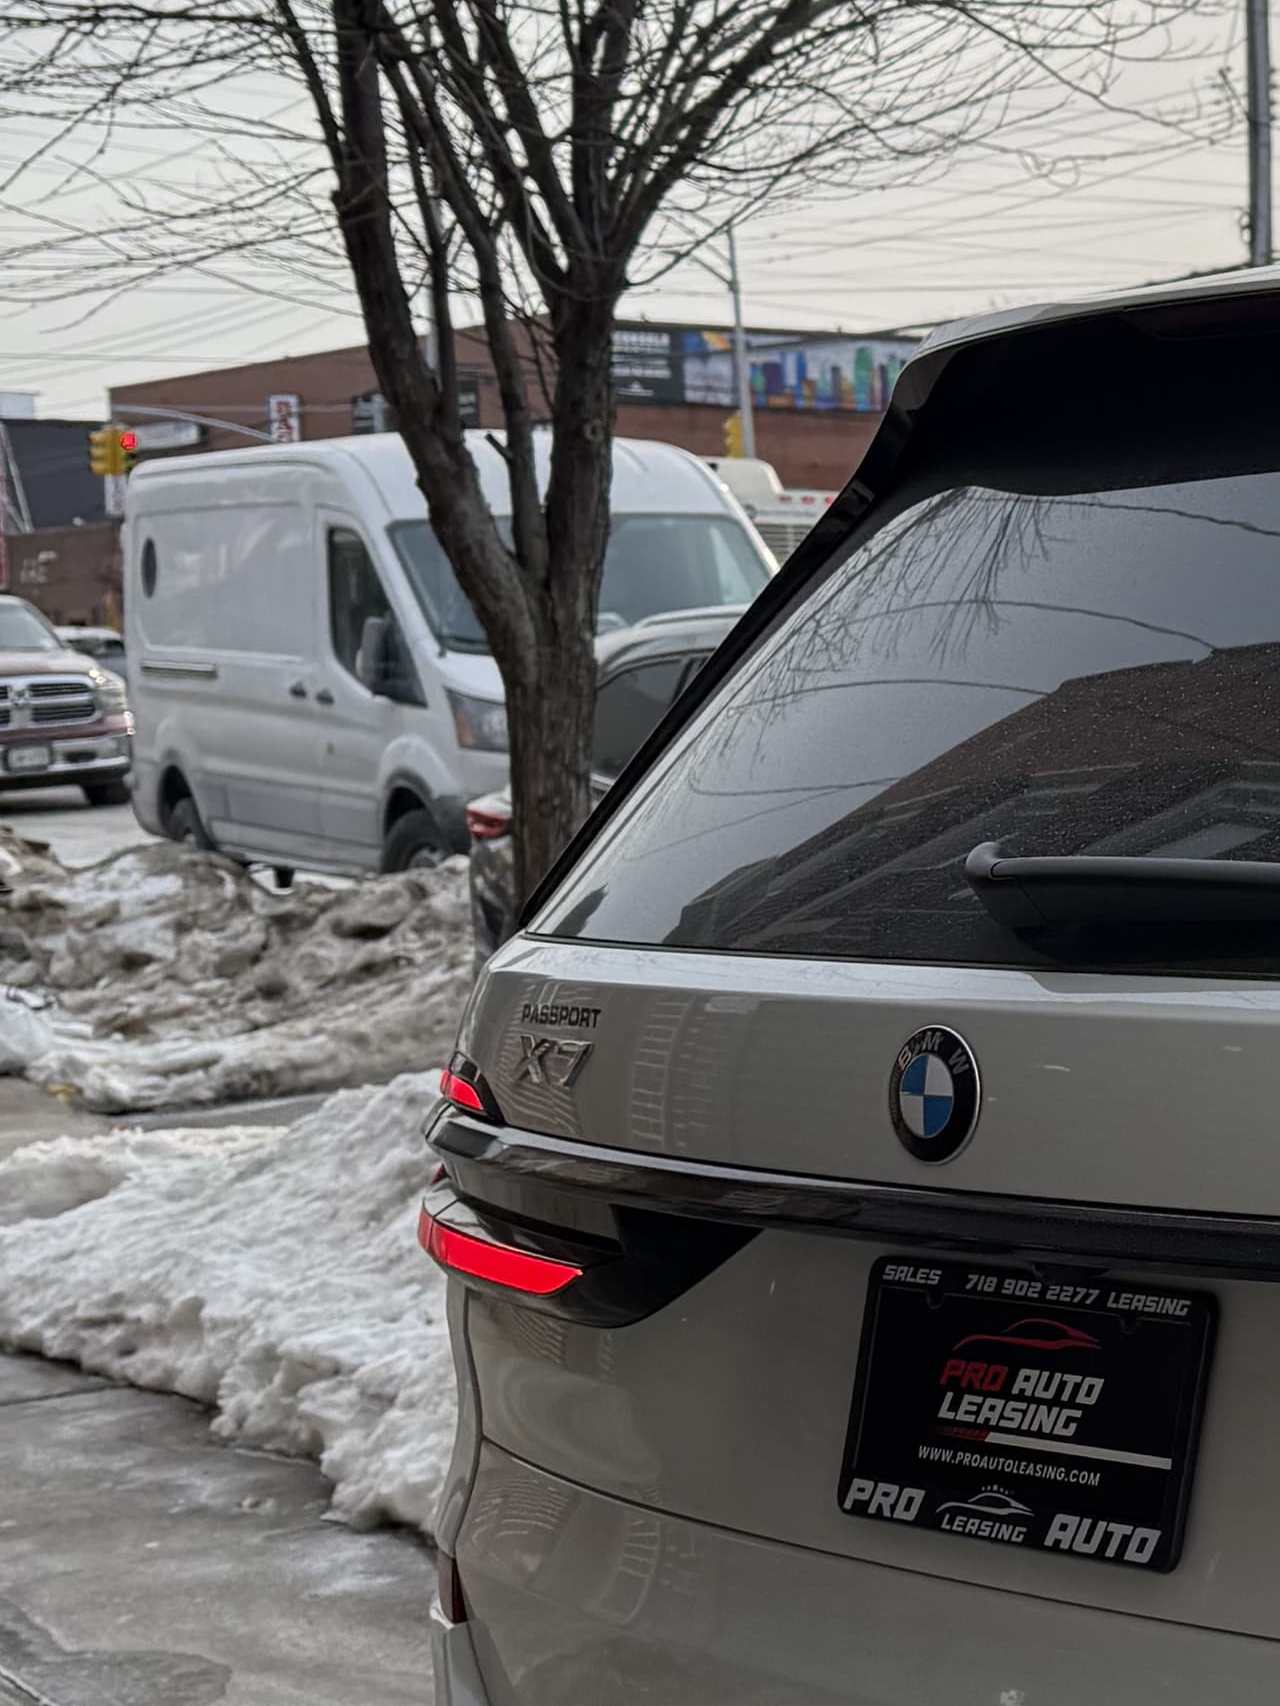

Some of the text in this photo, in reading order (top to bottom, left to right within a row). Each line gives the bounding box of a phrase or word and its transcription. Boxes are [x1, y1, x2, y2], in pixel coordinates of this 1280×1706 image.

[521, 1004, 602, 1029] PASSPORT
[513, 1033, 594, 1090] X7
[898, 1031, 970, 1075] BMW
[882, 1265, 1191, 1316] SALES 718 902 2277 LEASING
[939, 1359, 1105, 1405] PRO AUTO
[937, 1392, 1083, 1437] LEASING
[918, 1445, 1101, 1486] WWW.PROAUTOLEASING.COM
[843, 1478, 1161, 1563] PRO LEASING AUTO
